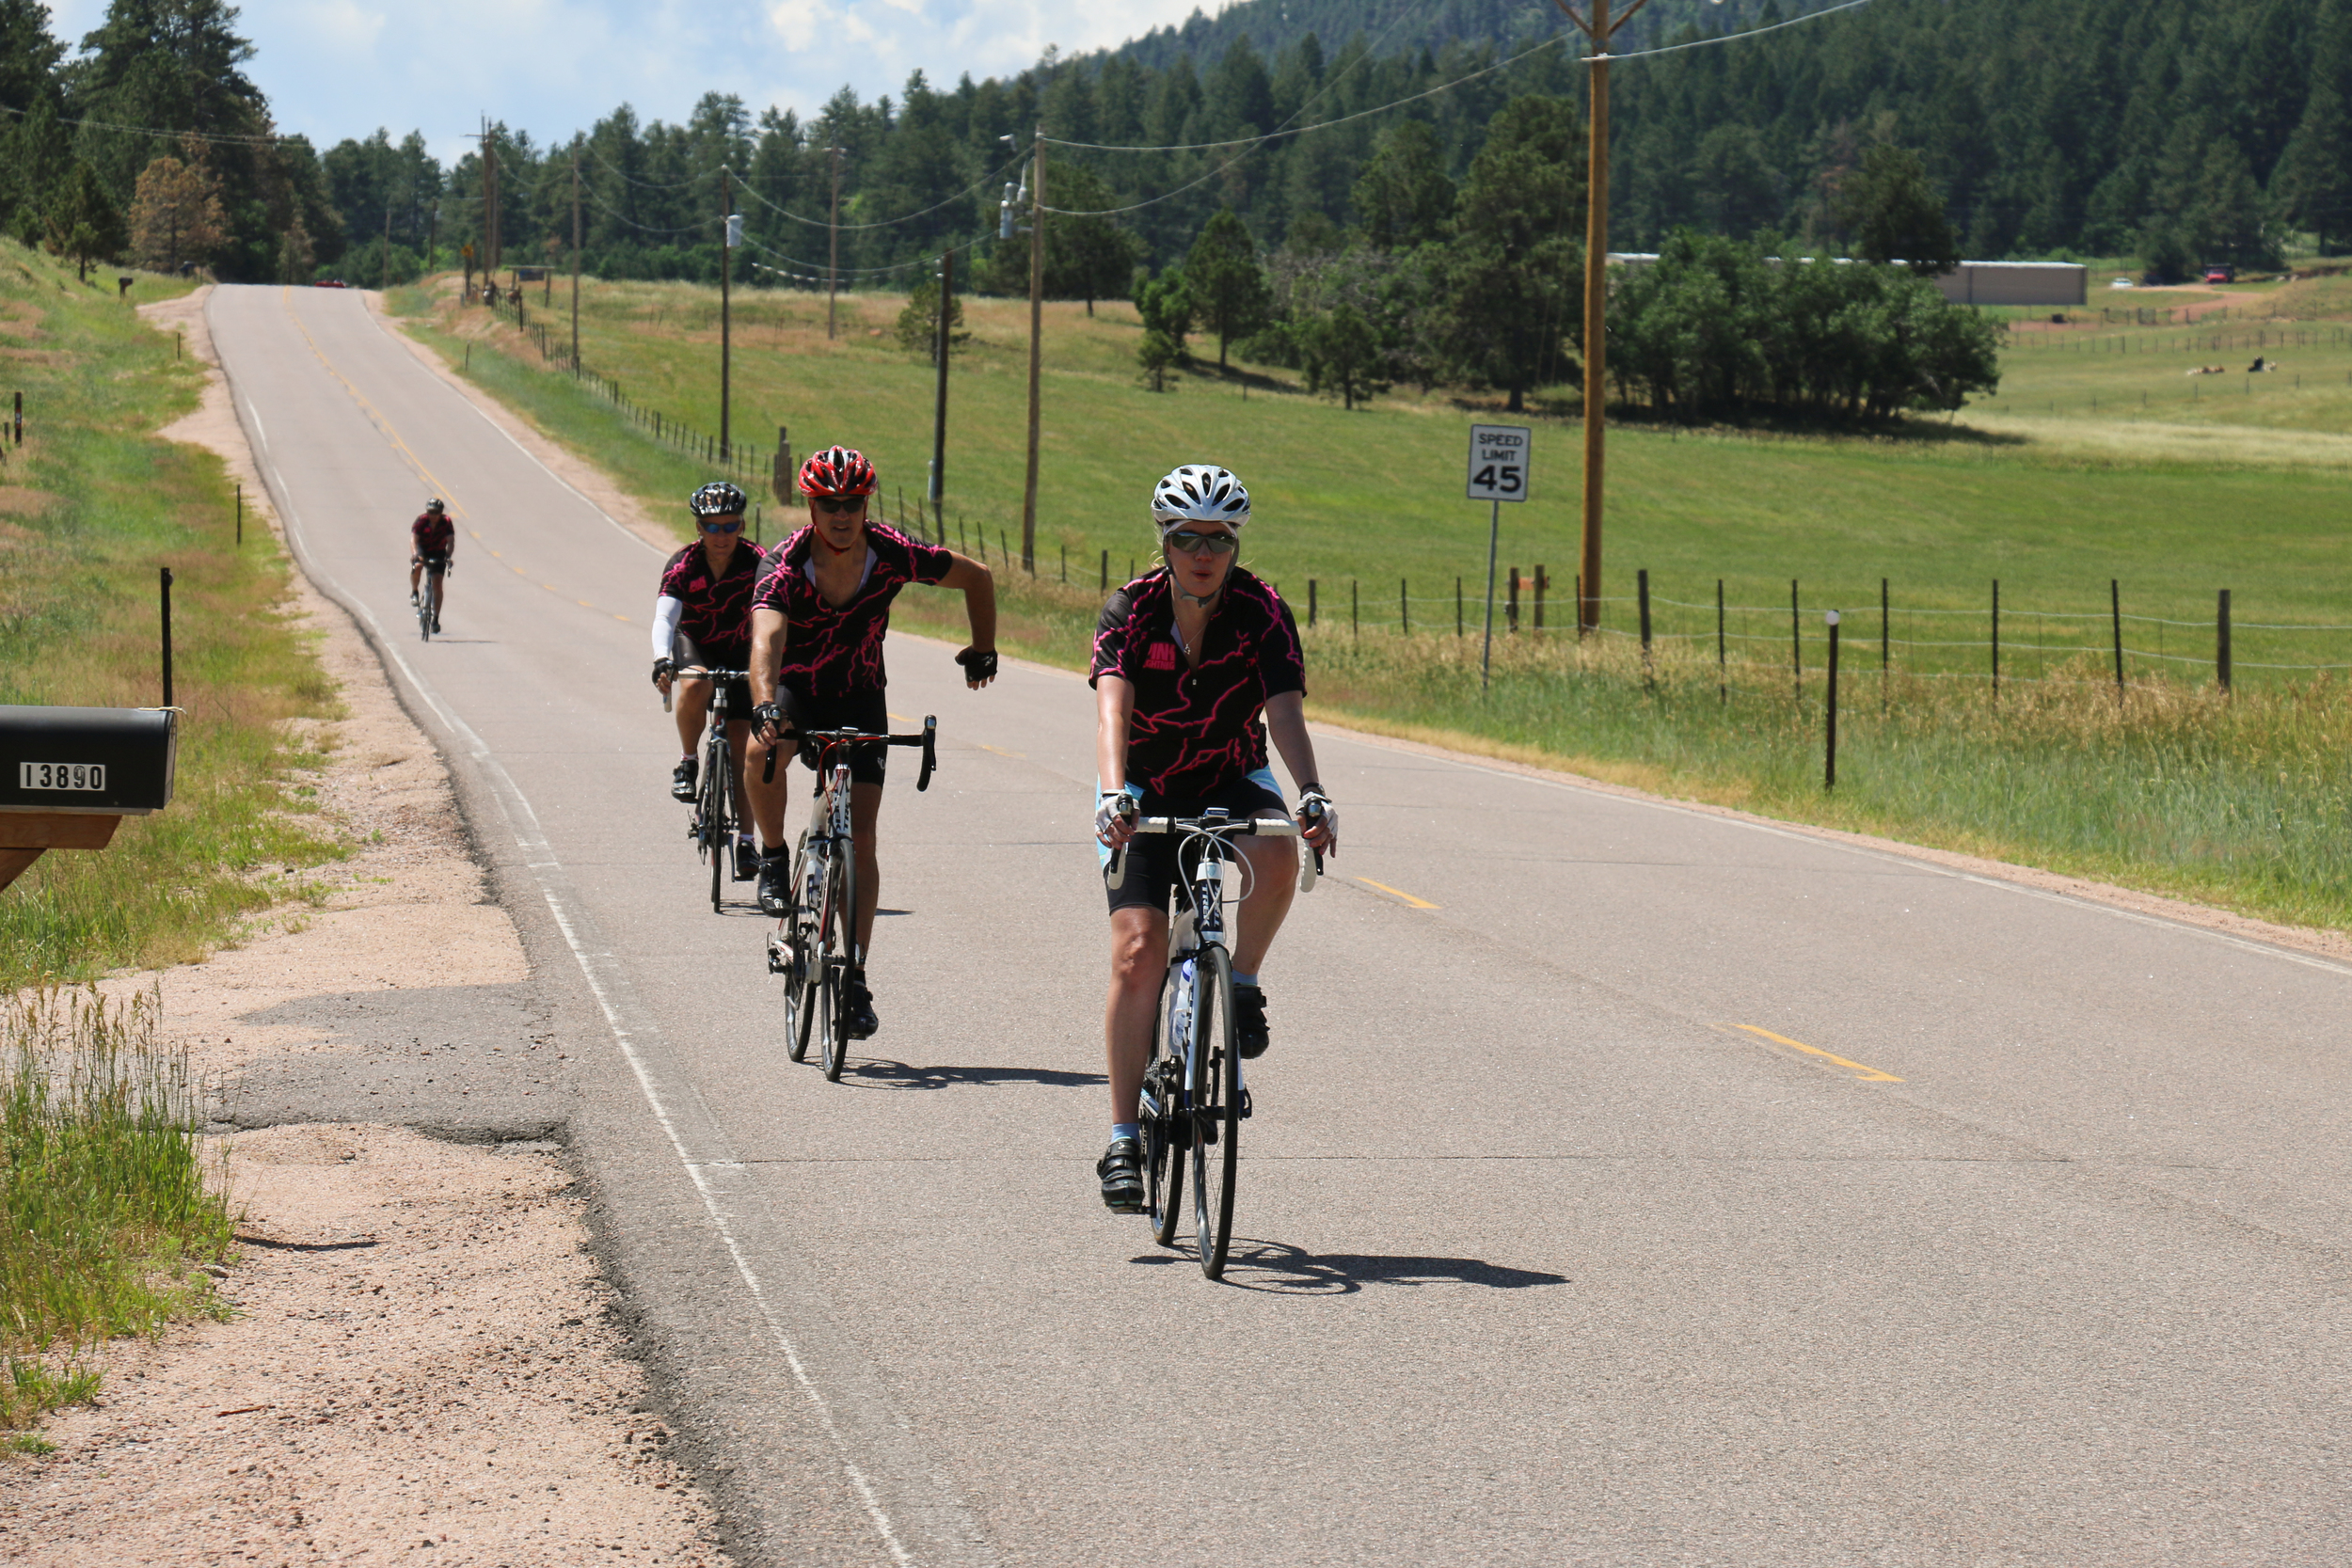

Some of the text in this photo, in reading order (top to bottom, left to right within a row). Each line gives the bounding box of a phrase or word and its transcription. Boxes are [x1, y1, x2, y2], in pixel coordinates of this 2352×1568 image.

[1479, 434, 1523, 447] SPEED
[1482, 449, 1517, 461] LIMIT
[1473, 465, 1521, 493] 45
[26, 765, 102, 789] 13890
[1201, 884, 1210, 927] TREK
